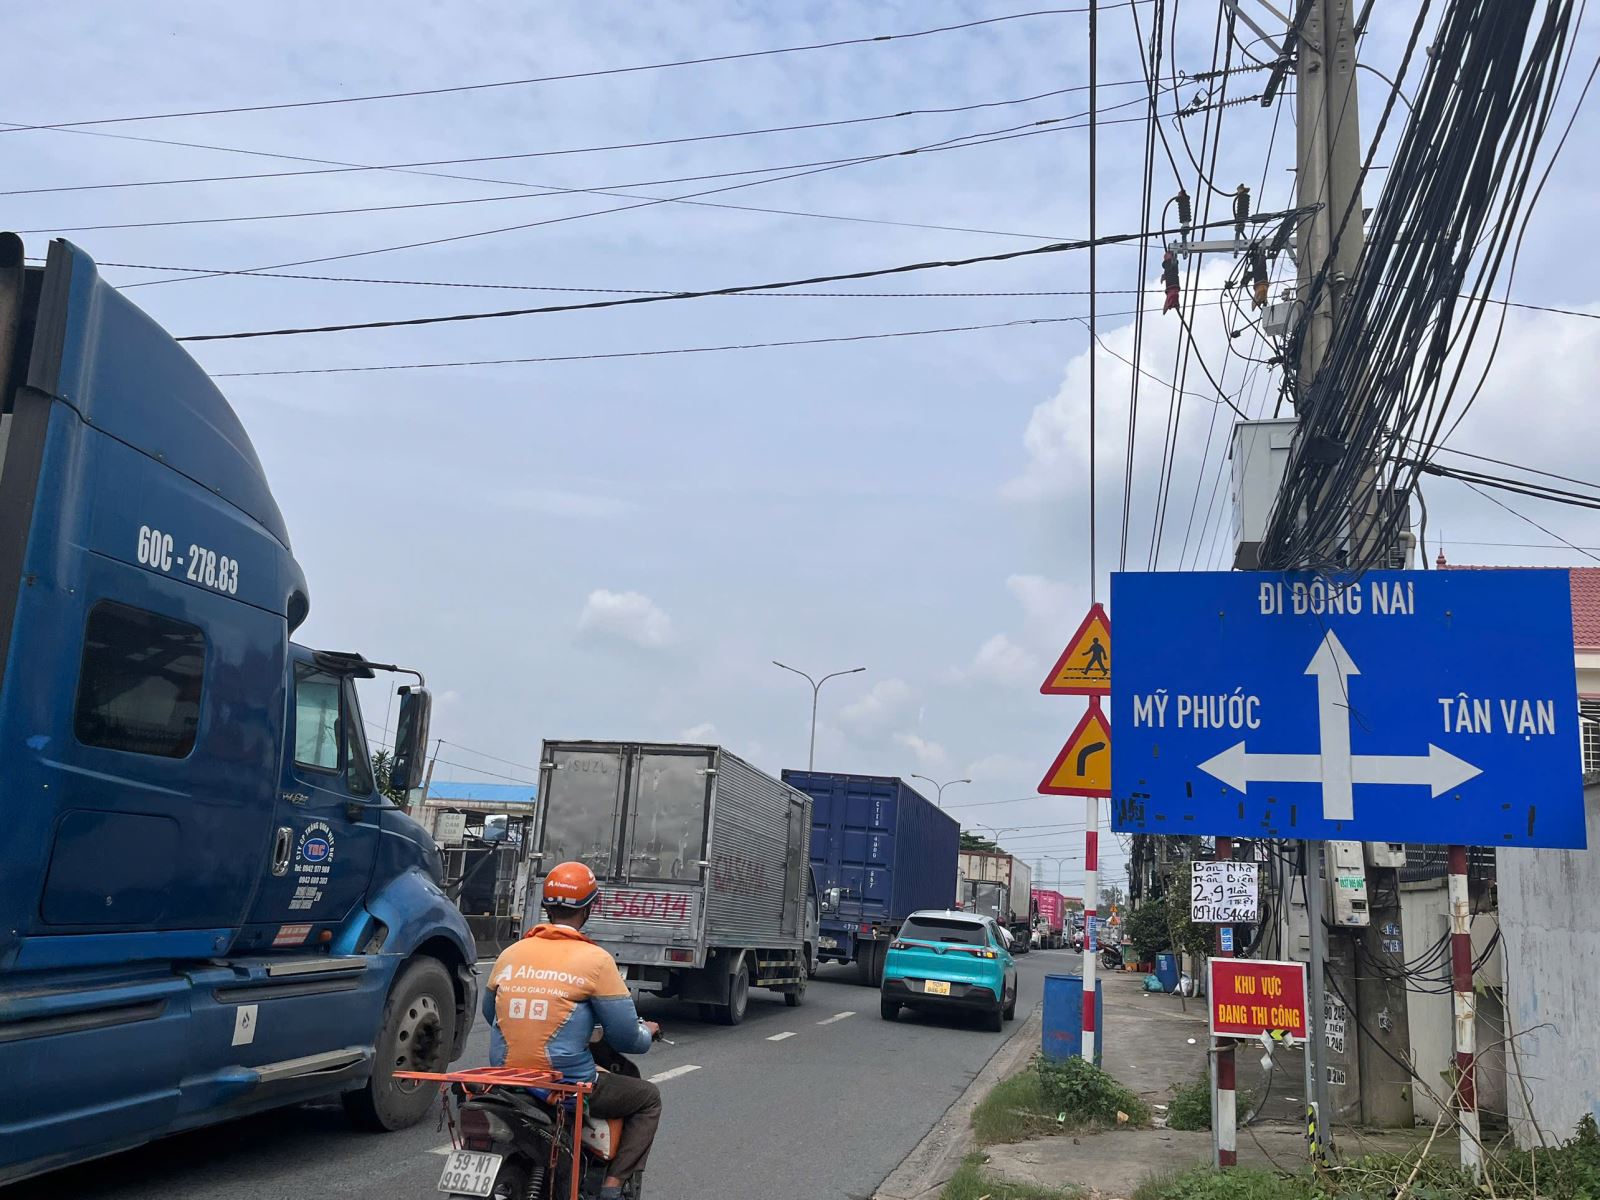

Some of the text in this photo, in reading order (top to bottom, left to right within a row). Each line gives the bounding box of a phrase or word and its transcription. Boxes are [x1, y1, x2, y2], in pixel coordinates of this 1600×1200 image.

[138, 525, 173, 572] 60C
[187, 544, 238, 594] 278.83
[1258, 582, 1282, 615] ĐI
[1372, 582, 1414, 615] NAI
[1133, 686, 1261, 729] MỸ PHƯỚC
[1438, 692, 1556, 741] TÂN VẠN
[514, 964, 585, 985] Ahamove
[511, 985, 526, 993] CAO
[527, 986, 546, 994] GIAO
[1234, 975, 1282, 999] KHU VỰC
[1218, 1004, 1300, 1028] ĐANG THI CÔNG
[453, 1153, 492, 1174] 59-N1
[442, 1171, 491, 1194] 996.18
